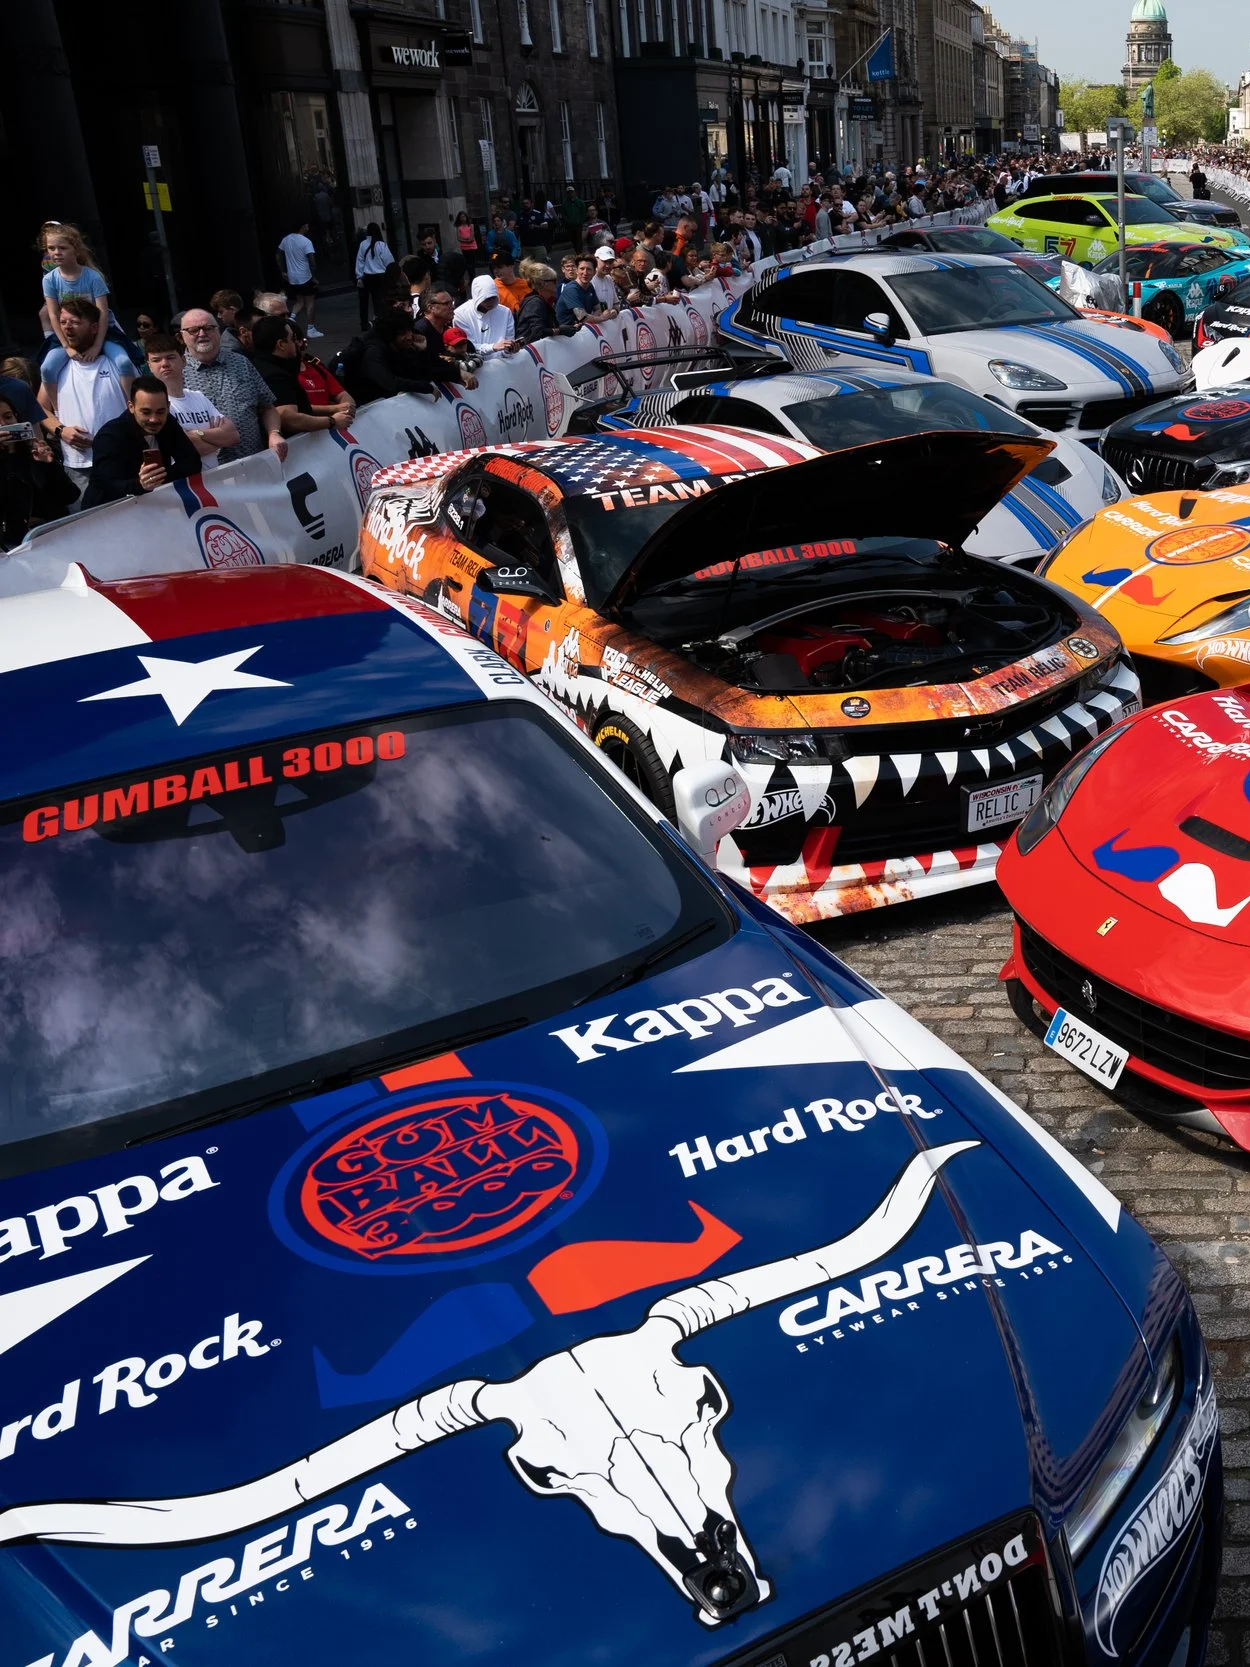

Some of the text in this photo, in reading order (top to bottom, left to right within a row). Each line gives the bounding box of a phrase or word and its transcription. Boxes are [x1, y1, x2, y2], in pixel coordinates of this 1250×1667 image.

[391, 40, 440, 68] wework
[871, 68, 890, 77] kettle
[497, 408, 517, 434] Hard
[517, 400, 534, 424] Rock
[591, 478, 714, 512] TEAM
[205, 529, 249, 562] GUM
[450, 550, 471, 573] TEAM
[694, 539, 857, 581] GUMBALL 3000
[1207, 641, 1228, 656] HOT
[623, 660, 673, 698] MICHELIN
[990, 657, 1067, 697] TEAM RELIC
[593, 725, 631, 747] MICHELIN
[22, 730, 407, 843] GUMBALL 3000
[971, 784, 1012, 800] WISCONSIN
[975, 787, 1035, 821] RELIC 1
[549, 972, 812, 1064] Kappa
[1057, 1018, 1123, 1080] 9672 LZW
[308, 1094, 528, 1182] GUM
[668, 1086, 938, 1179] Hard Rock
[322, 1118, 564, 1232] BALL
[0, 1152, 221, 1262] appa
[778, 1229, 1064, 1338] CARRERA
[796, 1253, 1076, 1354] EYEWEAR SINCE 1956
[92, 1312, 272, 1416] Rock
[1104, 1444, 1202, 1611] HOT WHEELS
[205, 1517, 419, 1629] SINCE 1956
